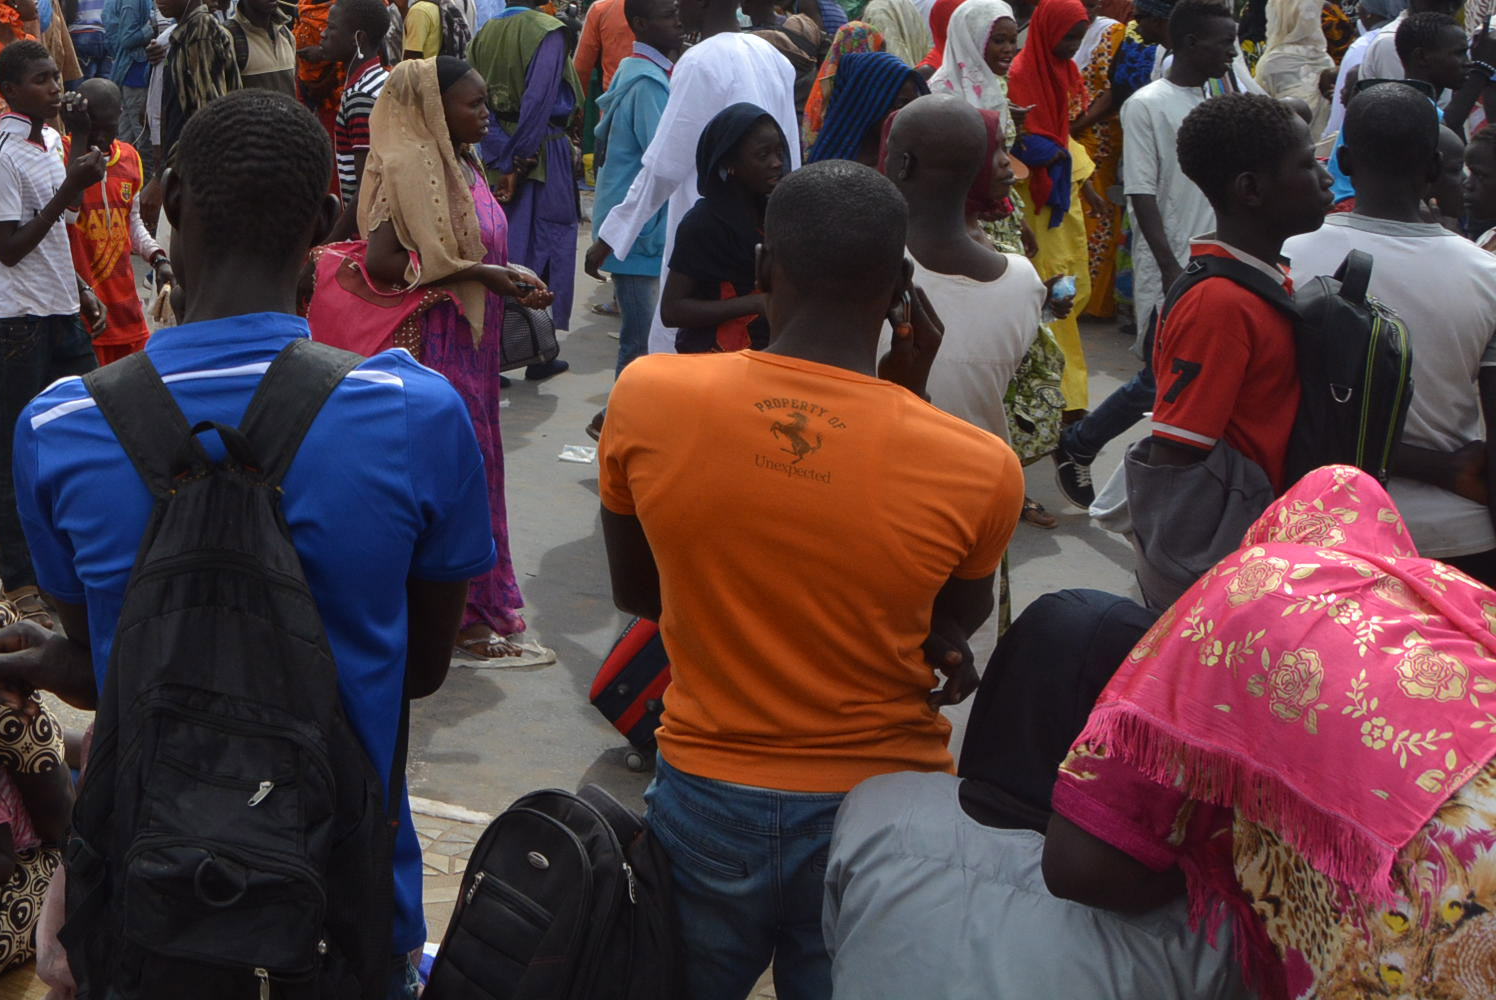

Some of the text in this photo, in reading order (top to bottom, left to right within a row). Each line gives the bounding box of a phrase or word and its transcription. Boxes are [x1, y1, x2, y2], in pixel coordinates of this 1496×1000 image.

[1162, 358, 1202, 405] 7
[754, 398, 847, 431] PROPERTY OF
